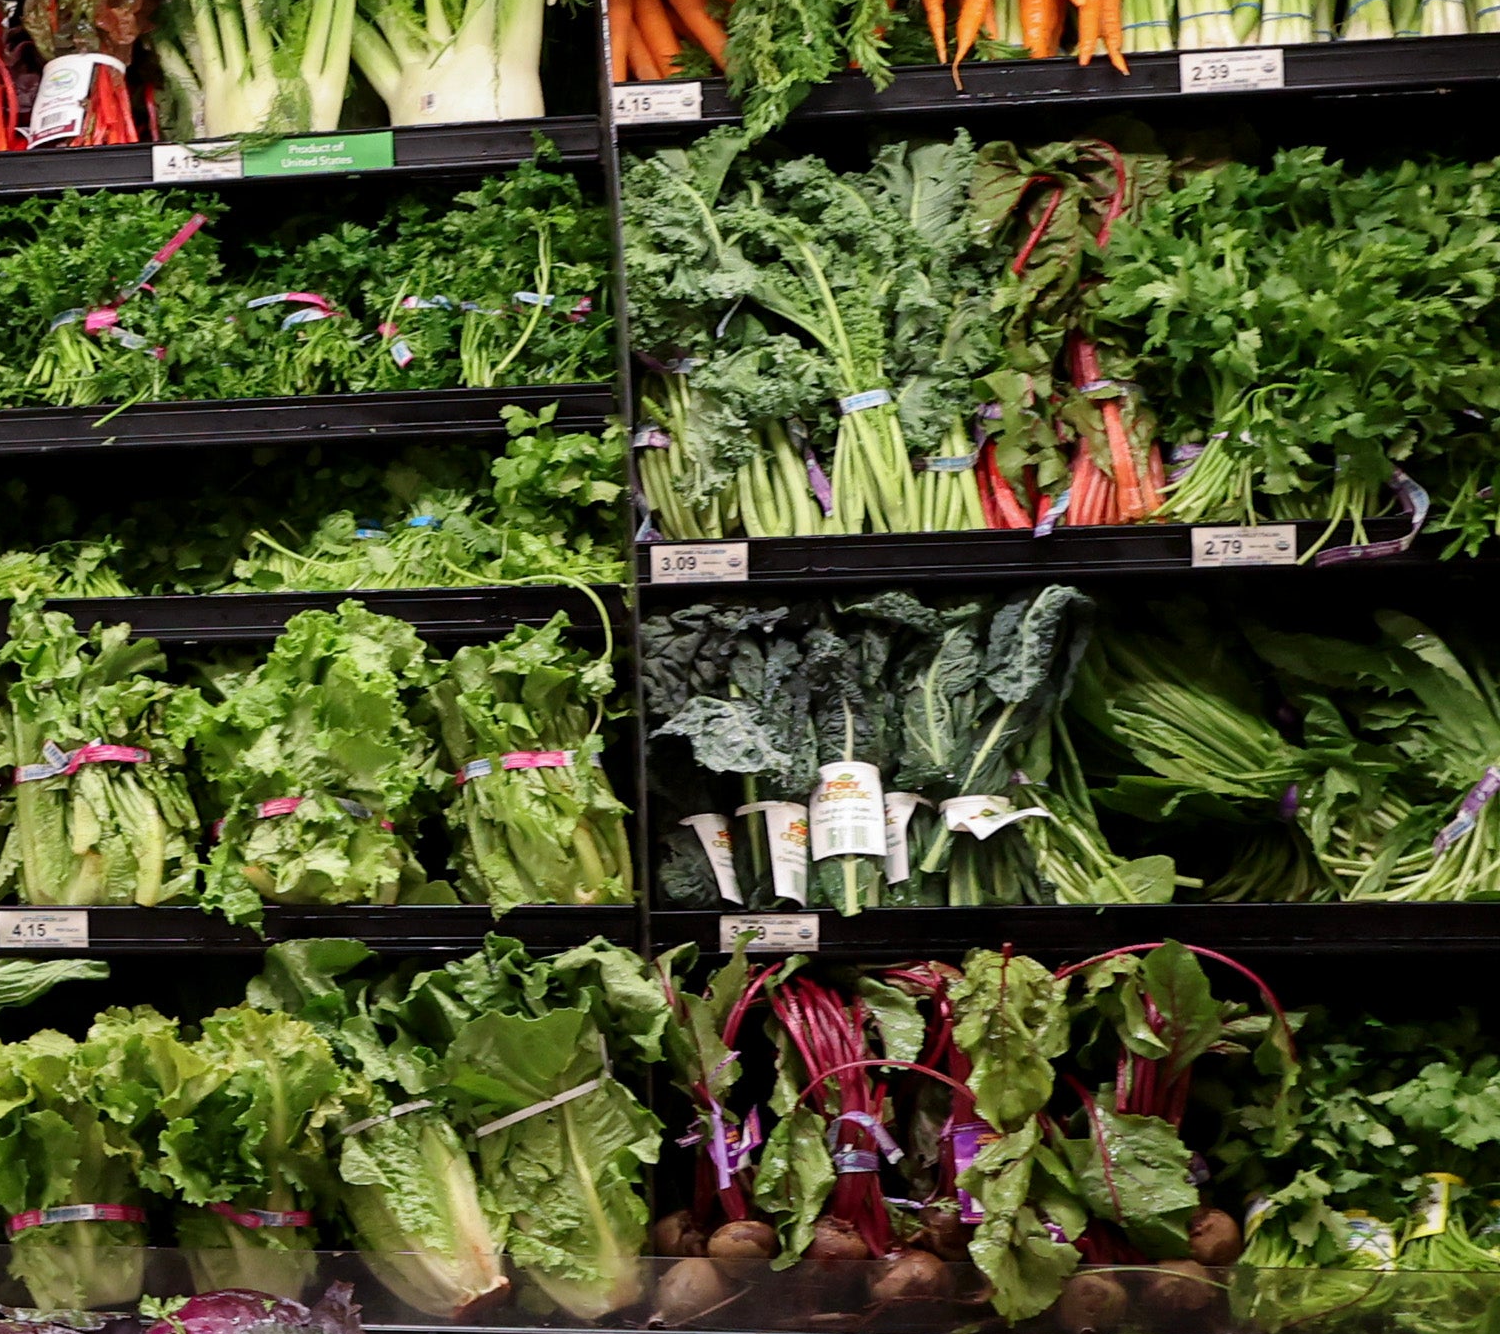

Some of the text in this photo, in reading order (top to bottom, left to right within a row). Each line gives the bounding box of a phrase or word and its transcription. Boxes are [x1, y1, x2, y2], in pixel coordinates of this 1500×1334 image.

[1192, 64, 1230, 80] 2.39
[616, 97, 651, 112] 4.15
[288, 142, 345, 155] Product of
[280, 154, 354, 169] United States
[1204, 539, 1243, 555] 2.79
[660, 555, 697, 571] 3.09
[825, 780, 861, 791] FOXY
[12, 923, 46, 938] 4.15
[730, 925, 767, 940] 39
